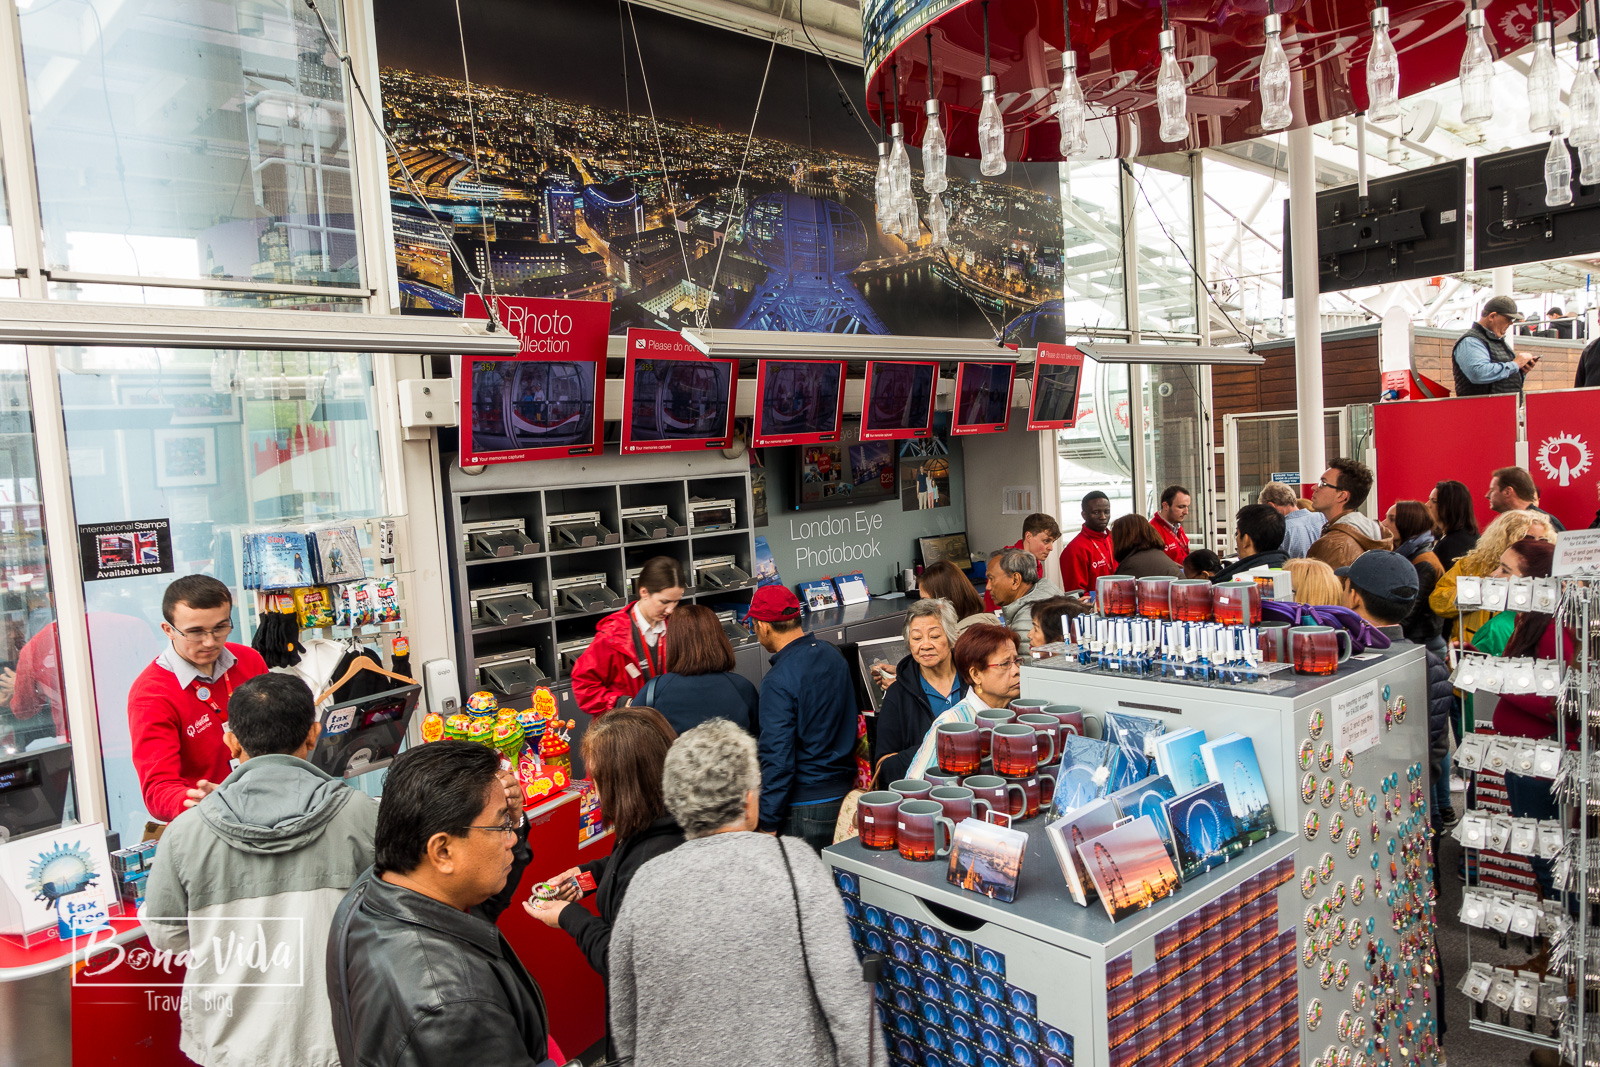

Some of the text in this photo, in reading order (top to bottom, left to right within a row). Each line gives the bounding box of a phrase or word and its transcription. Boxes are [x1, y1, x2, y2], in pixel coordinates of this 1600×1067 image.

[508, 306, 573, 335] Photo
[519, 336, 570, 353] ollection
[648, 340, 672, 351] Please
[674, 342, 683, 351] do
[480, 363, 496, 372] 357
[641, 363, 654, 371] 355
[880, 473, 894, 484] £25
[80, 521, 168, 534] International Stamps
[790, 511, 882, 541] London Eye
[796, 537, 881, 569] Photobook
[96, 566, 162, 579] Available here
[535, 694, 553, 704] Chupa
[535, 703, 554, 713] Chups
[331, 714, 349, 724] tax
[328, 722, 350, 732] free
[425, 721, 441, 730] Chupa
[527, 780, 552, 798] mega
[67, 901, 97, 914] tax
[68, 912, 105, 929] free
